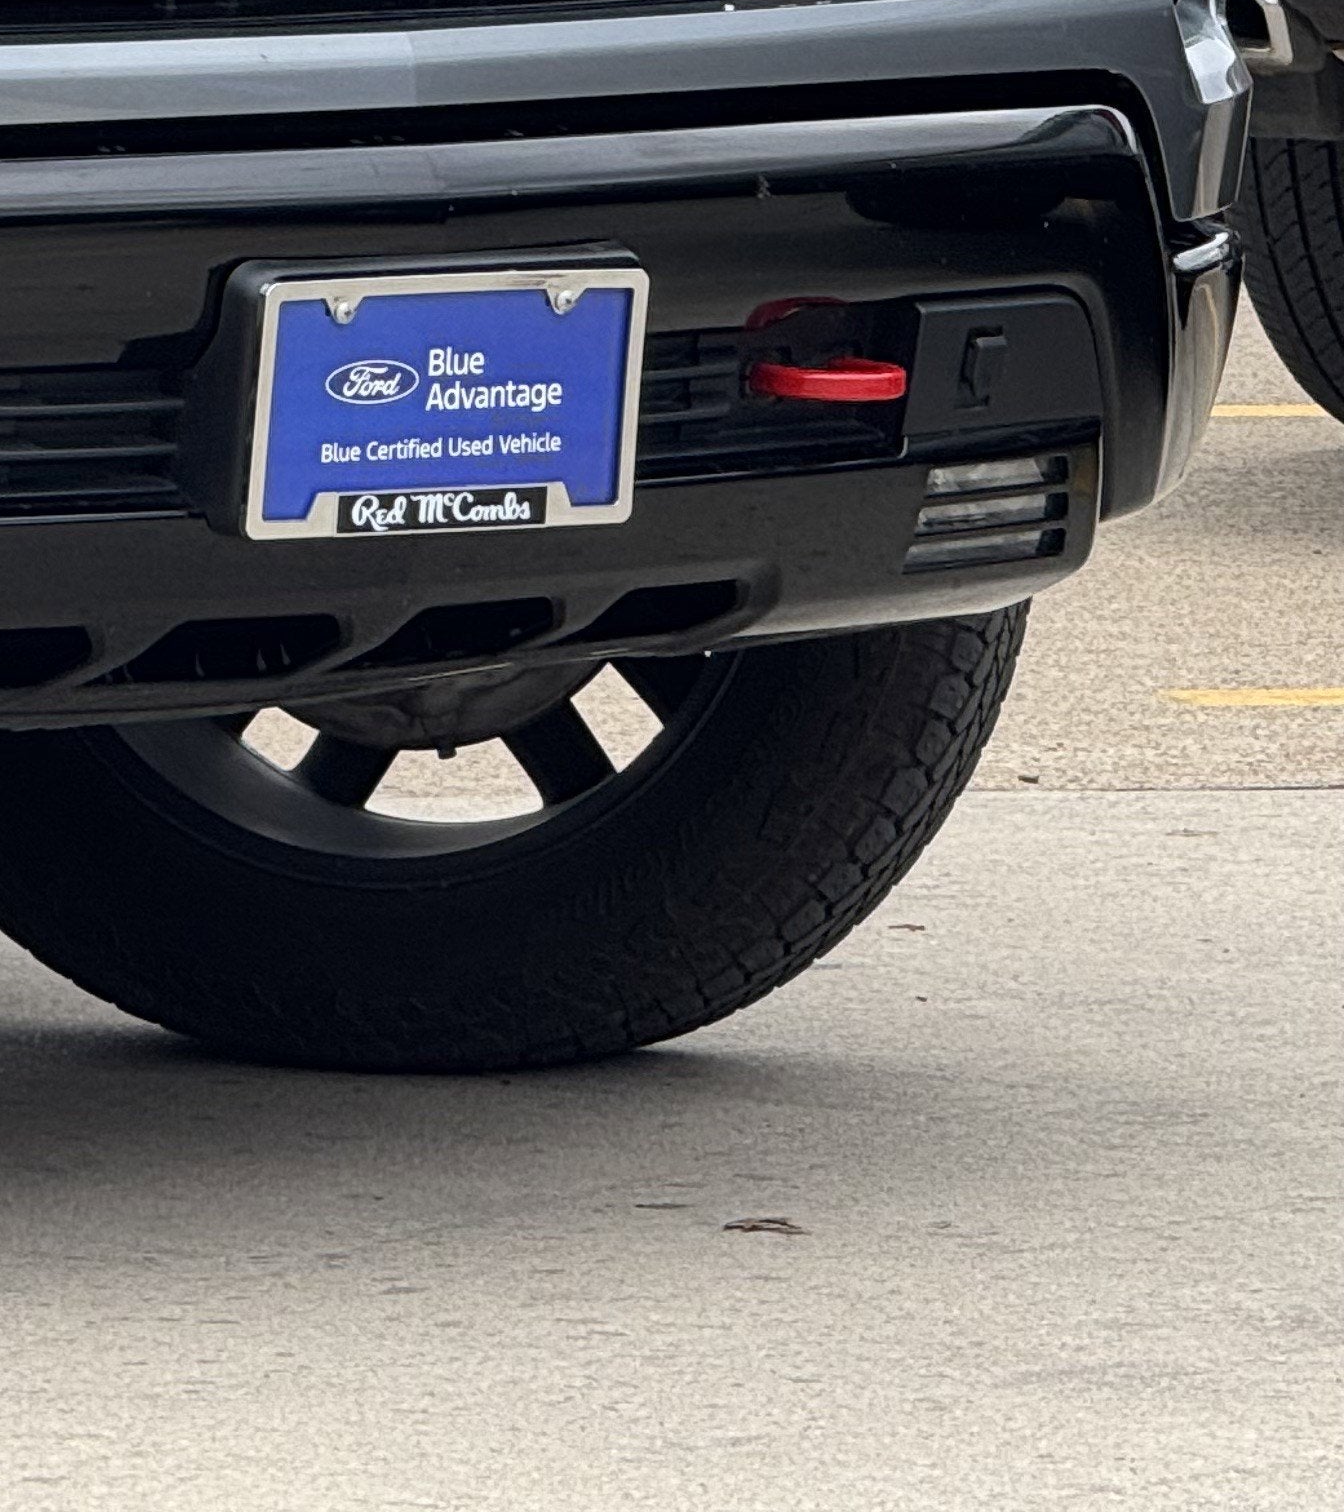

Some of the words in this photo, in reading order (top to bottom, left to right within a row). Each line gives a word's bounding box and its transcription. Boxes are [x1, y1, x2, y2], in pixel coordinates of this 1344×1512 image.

[428, 346, 485, 377] Blue
[342, 365, 402, 397] Ford
[425, 381, 563, 412] Advantage
[320, 443, 361, 463] Blue
[366, 438, 443, 461] Certified
[448, 436, 494, 457] Used
[499, 432, 562, 454] Vehicle
[351, 494, 407, 532] Red
[410, 492, 531, 524] McCombs
